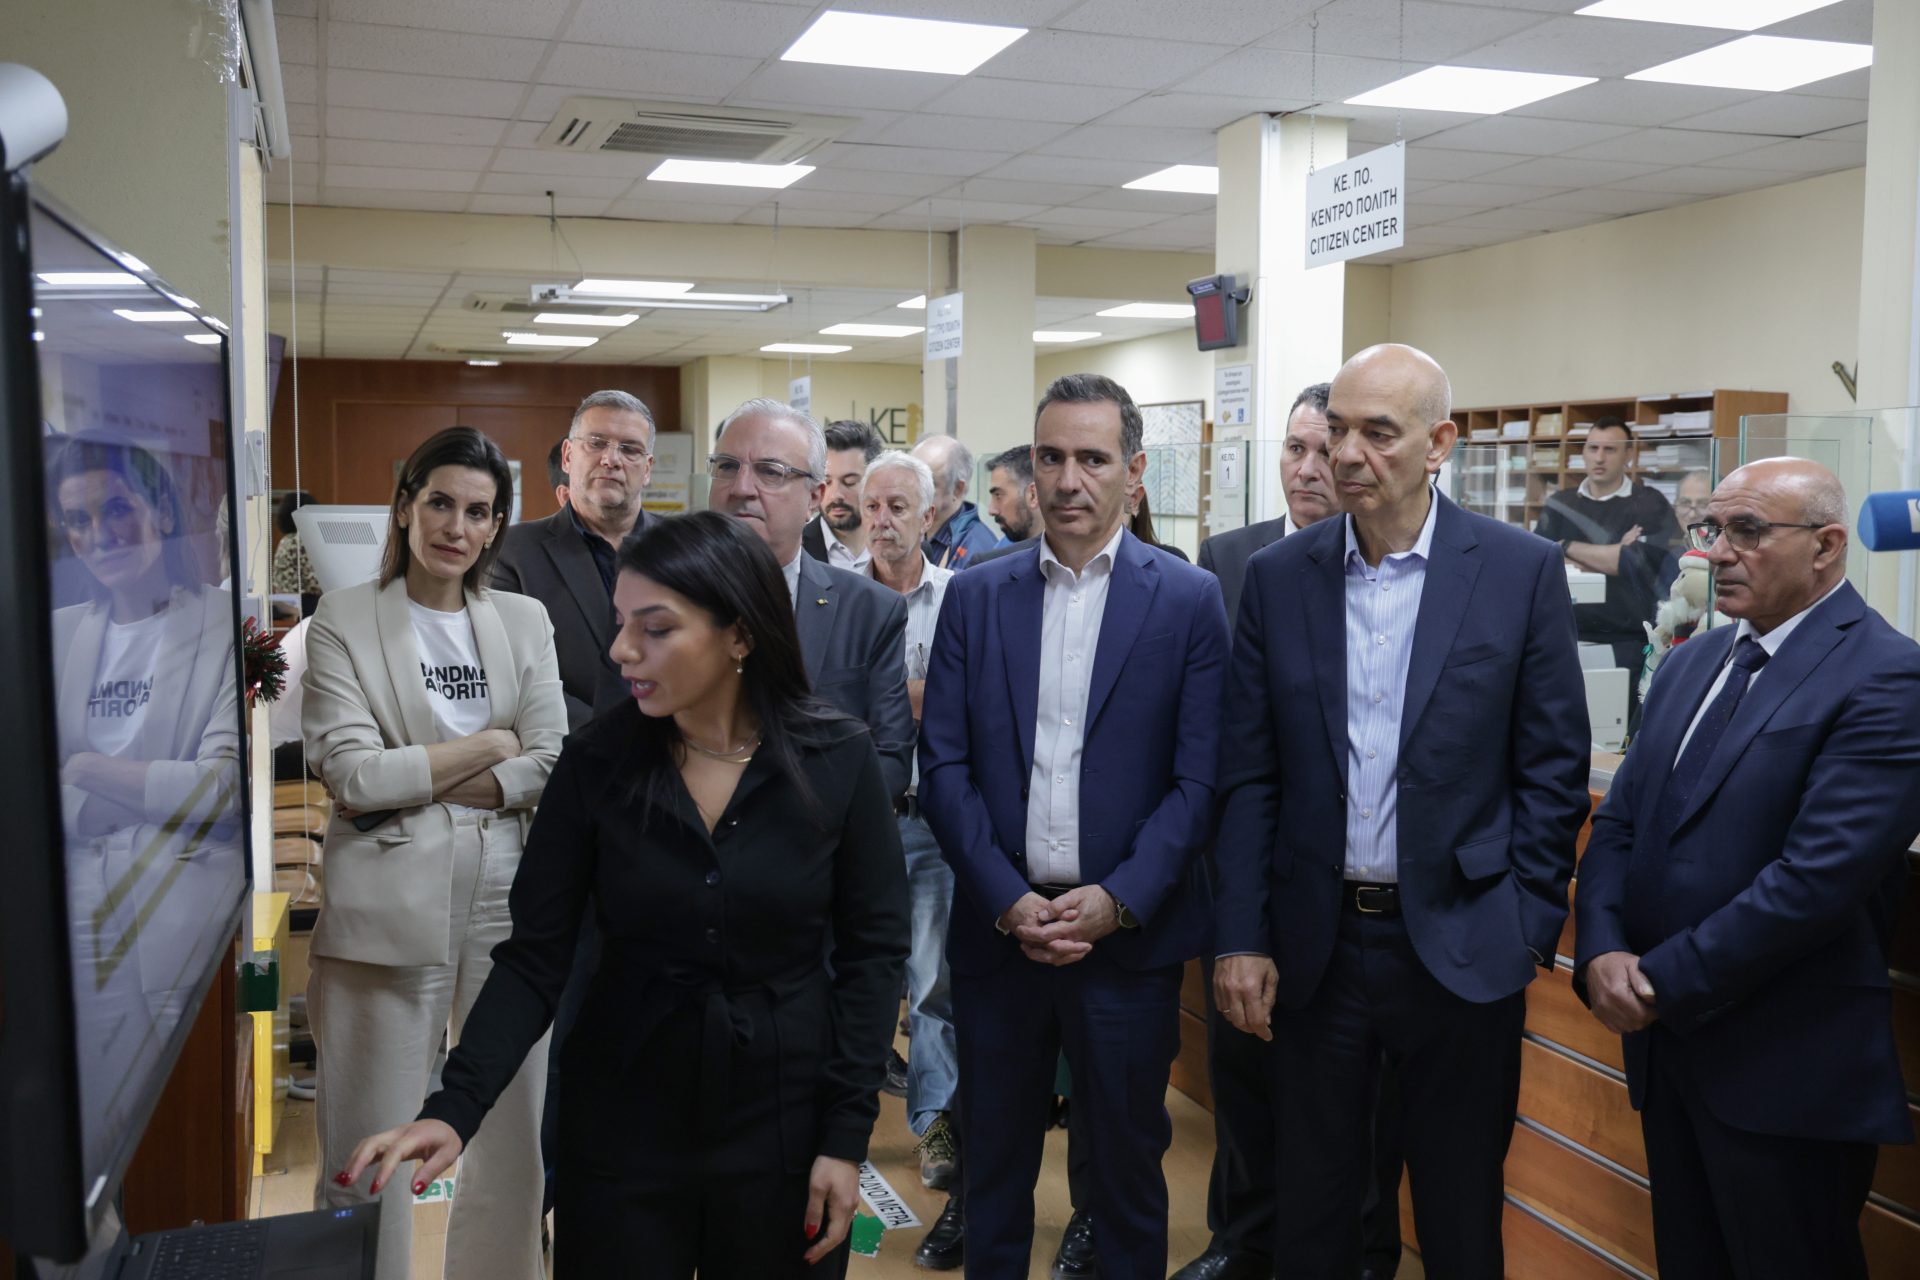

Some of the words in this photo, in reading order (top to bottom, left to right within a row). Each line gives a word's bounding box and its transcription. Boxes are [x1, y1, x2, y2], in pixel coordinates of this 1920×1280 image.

[1354, 167, 1373, 188] ΠΟ.
[1311, 200, 1353, 228] ΚΕΝΤΡΟ
[1356, 187, 1397, 215] ΠΟΛΙΤΗ
[1310, 230, 1350, 255] CITIZEN
[1352, 217, 1398, 244] CENTER
[874, 1199, 912, 1226] ΜΕΤΡΑ
